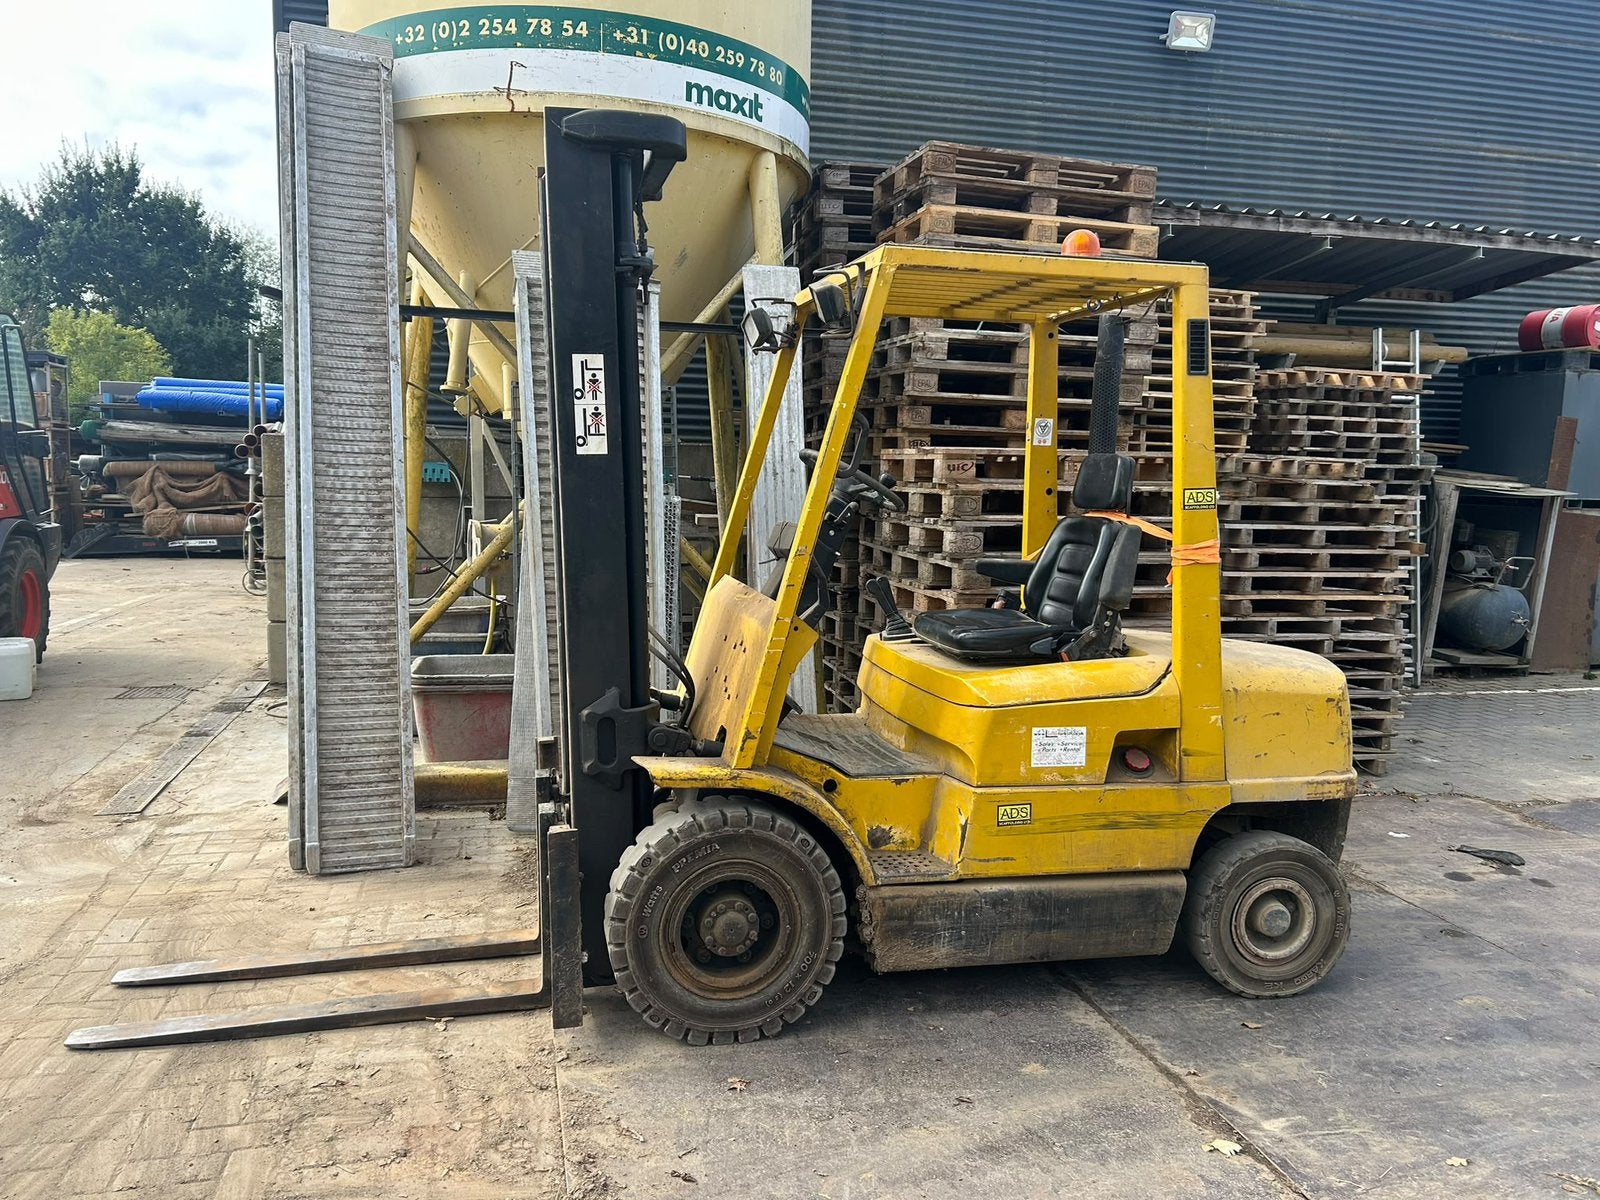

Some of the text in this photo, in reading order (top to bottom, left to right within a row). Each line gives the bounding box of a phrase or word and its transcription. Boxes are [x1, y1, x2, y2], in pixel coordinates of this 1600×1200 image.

[395, 18, 589, 45] +32 (0)2 254 78 54
[613, 26, 783, 86] +31 (0)40 259 78 80
[685, 80, 764, 123] maxit
[1186, 491, 1213, 504] ADS
[1001, 806, 1028, 820] ADS
[642, 842, 720, 917] Watts PREMIA
